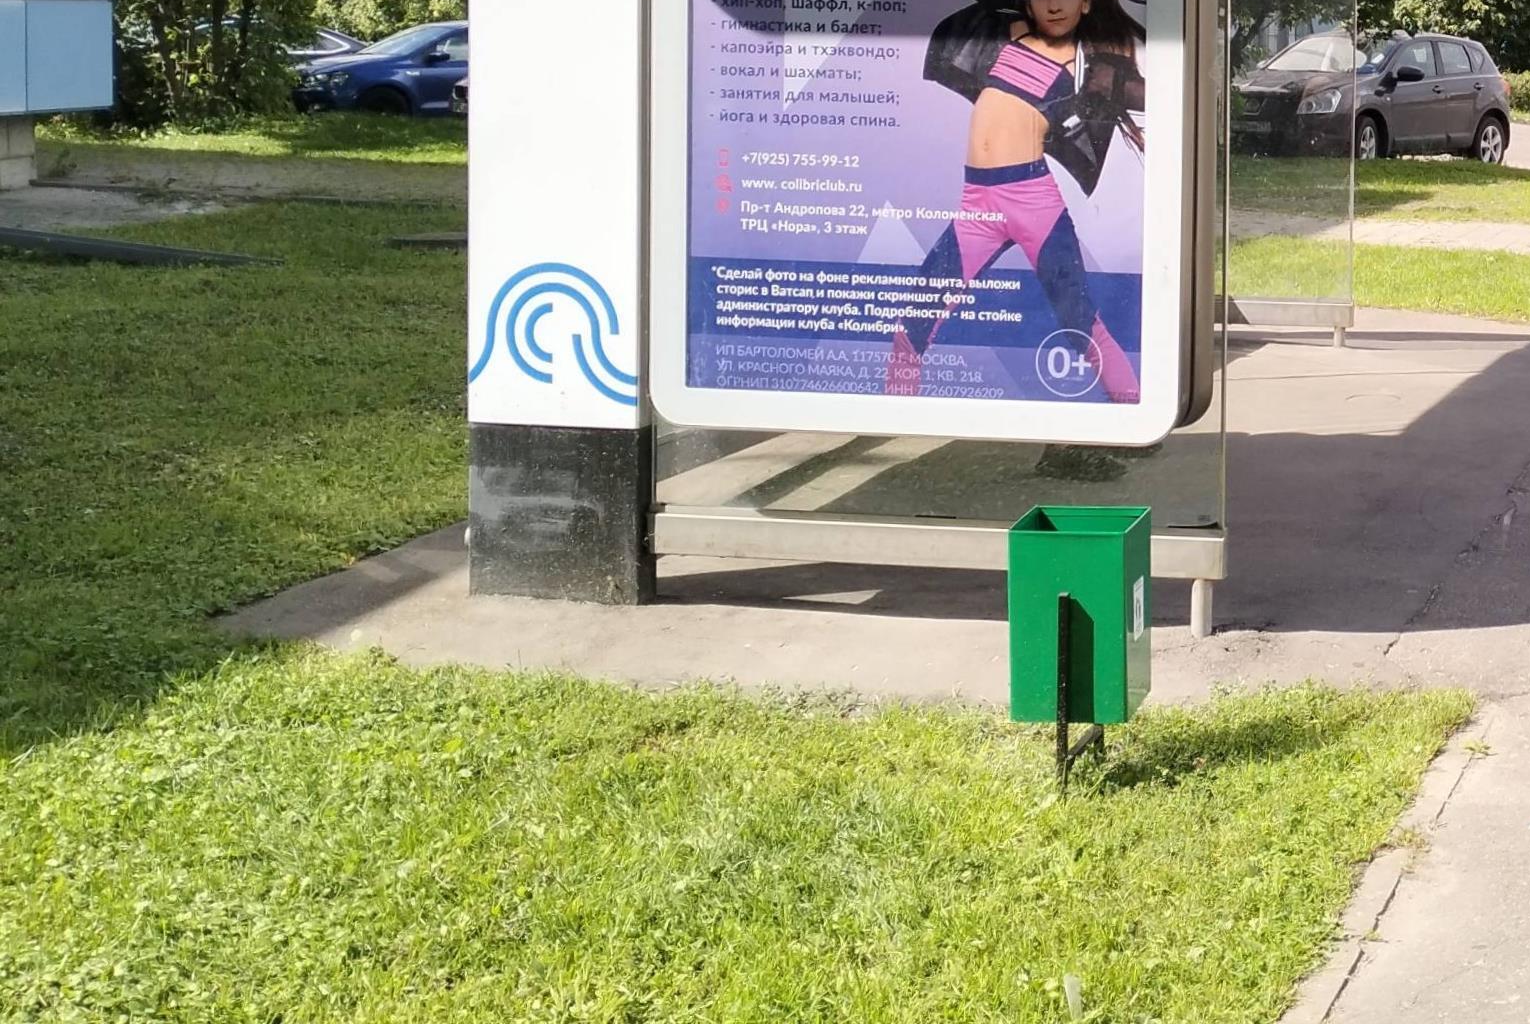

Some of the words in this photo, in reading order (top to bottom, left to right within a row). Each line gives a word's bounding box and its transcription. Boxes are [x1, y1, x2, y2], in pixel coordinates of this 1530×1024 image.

[857, 0, 907, 13] к-поп;
[721, 20, 811, 33] гимнастика
[816, 22, 826, 33] и
[830, 19, 882, 35] балет;
[720, 41, 793, 56] капоэйра
[798, 45, 807, 55] и
[812, 45, 900, 59] тхэквондо;
[720, 66, 765, 77] вокал
[770, 67, 779, 77] и
[784, 68, 862, 81] шахматы;
[720, 88, 780, 101] занятия
[784, 91, 814, 103] для
[819, 90, 900, 106] малышей;
[719, 108, 754, 123] йога
[759, 113, 768, 123] и
[773, 113, 845, 127] здоровая
[850, 115, 901, 128] спина.
[742, 152, 790, 166] +7(925)
[792, 153, 860, 168] 755-99-12
[740, 200, 771, 215] Пр-т
[774, 202, 846, 217] Андропова
[848, 204, 869, 219] 22,
[871, 207, 912, 219] метро
[740, 218, 768, 232] ТРЦ
[823, 221, 832, 233] 3
[835, 224, 868, 235] этаж
[765, 268, 797, 282] фото
[799, 271, 814, 282] на
[816, 270, 849, 284] фоне
[851, 274, 927, 287] рекламного
[929, 277, 966, 289] щита,
[968, 278, 1021, 290] выложи
[716, 284, 759, 296] сторис
[761, 286, 768, 296] в
[817, 288, 825, 298] и
[827, 289, 875, 300] покажи
[877, 290, 940, 303] скриншот
[942, 290, 976, 305] фото
[716, 300, 822, 316] администратору
[821, 304, 862, 317] клуба.
[864, 304, 950, 319] Подробности
[960, 309, 976, 320] на
[978, 309, 1023, 322] стойке
[716, 314, 795, 330] информации
[798, 318, 835, 331] клуба
[716, 344, 735, 355] ИП
[737, 345, 825, 362] БАРТОЛОМЕЙ
[1047, 346, 1092, 378] 0+
[738, 361, 805, 375] КРАСНОГО
[884, 383, 913, 395] ИНН
